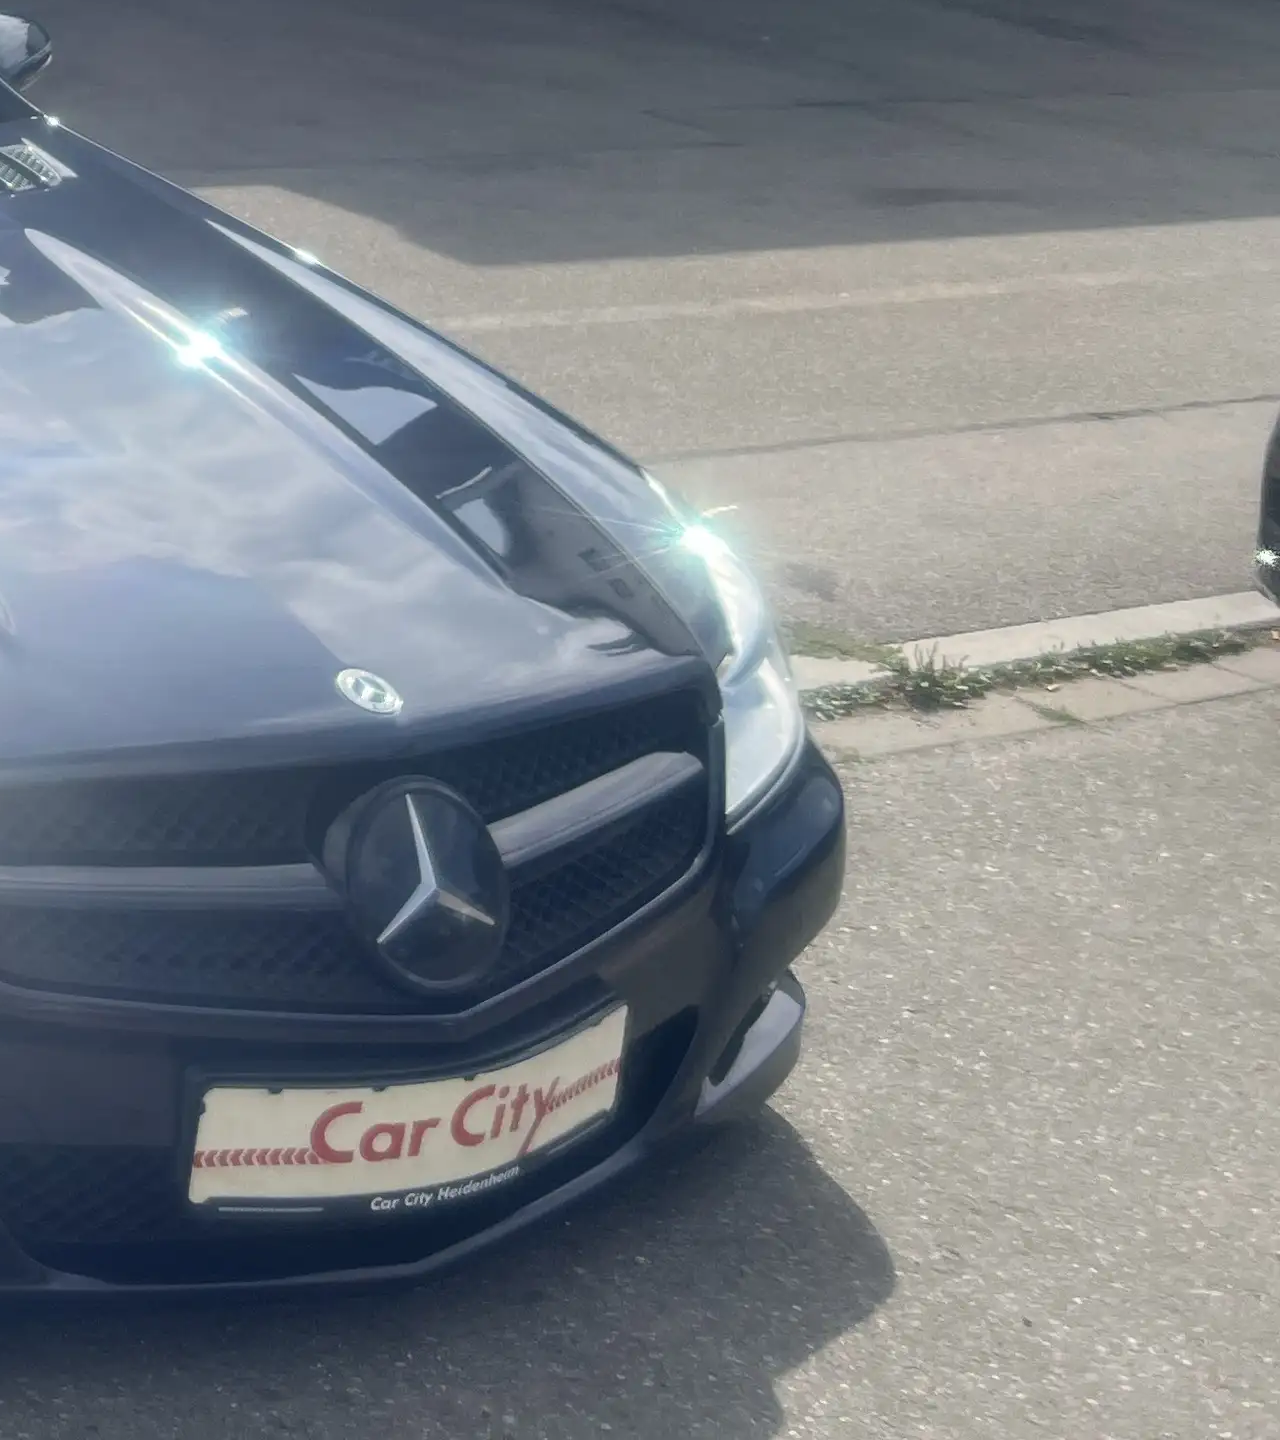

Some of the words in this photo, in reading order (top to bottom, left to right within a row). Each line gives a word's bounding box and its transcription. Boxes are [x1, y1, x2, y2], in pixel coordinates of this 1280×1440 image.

[310, 1101, 441, 1164] Car
[451, 1076, 561, 1161] City
[370, 1196, 399, 1211] Car
[404, 1191, 434, 1207] City
[437, 1164, 520, 1201] Heidenheim
